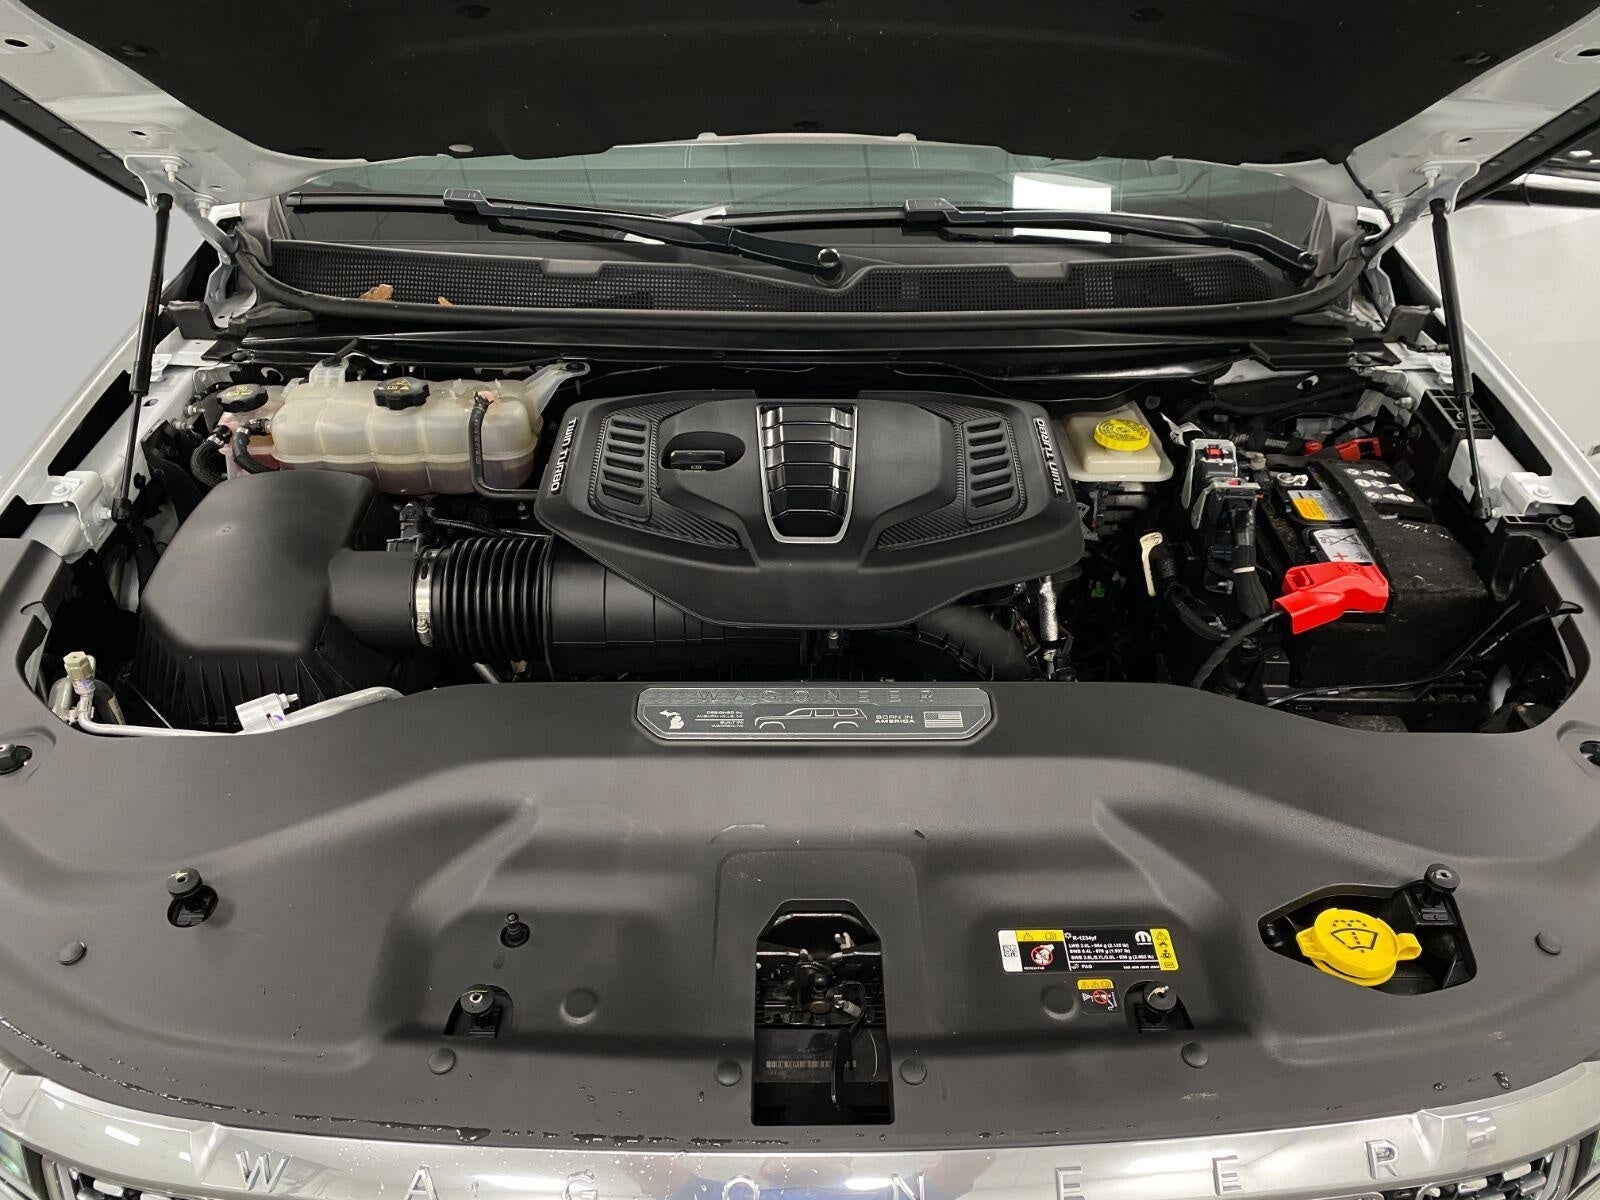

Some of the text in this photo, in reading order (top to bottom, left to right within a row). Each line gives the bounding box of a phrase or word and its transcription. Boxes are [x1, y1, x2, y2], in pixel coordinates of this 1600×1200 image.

[551, 417, 577, 491] TWIN TURBO
[1037, 418, 1064, 495] TWIN TURBO
[698, 689, 933, 702] WAGONEER
[235, 1139, 1400, 1200] WAGONEER
